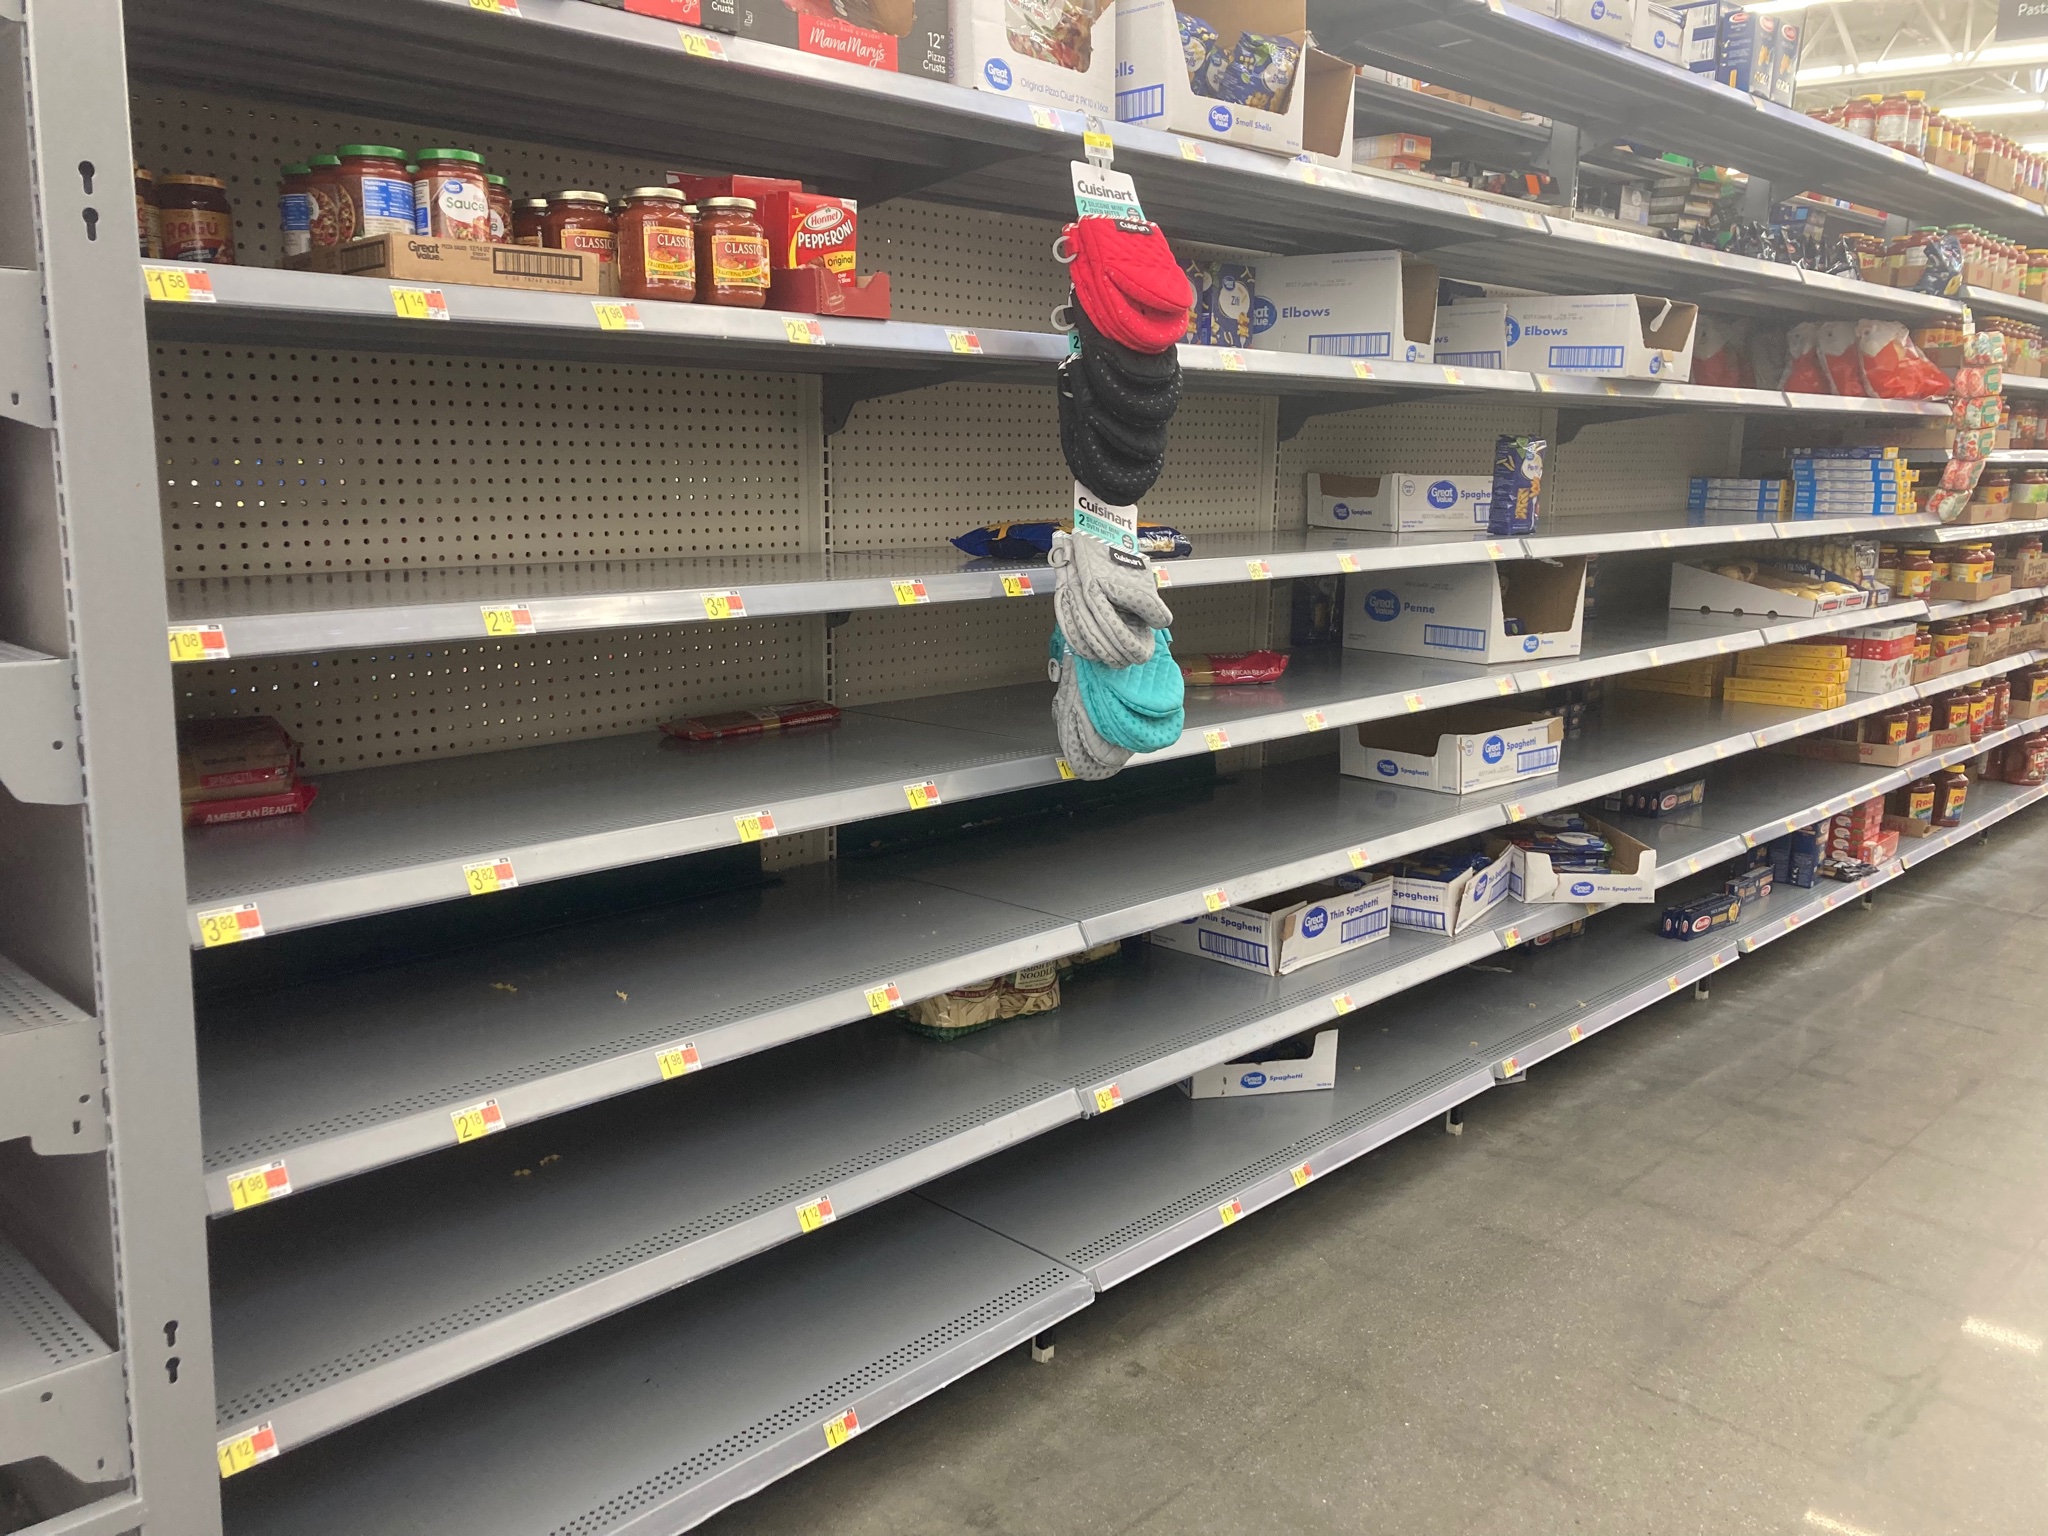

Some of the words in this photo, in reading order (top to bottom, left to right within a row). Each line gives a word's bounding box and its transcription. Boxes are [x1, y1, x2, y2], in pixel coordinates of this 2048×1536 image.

[711, 2, 735, 15] Crusts
[927, 50, 946, 64] Pizza
[923, 60, 946, 74] Crusts
[987, 63, 1008, 79] Great
[1020, 78, 1044, 93] Original
[1044, 86, 1060, 98] Pizza
[1060, 90, 1075, 103] Crust
[1211, 110, 1229, 121] Great
[1235, 117, 1253, 128] Small
[1254, 121, 1272, 132] Shells
[1077, 180, 1134, 202] Cuisinart
[446, 196, 485, 213] Sauce
[1081, 199, 1089, 213] 2
[810, 211, 839, 227] Hormel
[797, 219, 854, 249] PEPPERONI
[408, 240, 440, 254] Great
[827, 255, 854, 269] Original
[1282, 307, 1331, 319] Elbows
[1524, 325, 1568, 337] Elbows
[1431, 487, 1454, 499] Great
[1078, 496, 1133, 531] Cuisinart
[1078, 513, 1086, 527] 2
[1086, 516, 1108, 530] SILICONE
[1108, 523, 1120, 536] MINI
[1086, 522, 1099, 533] OVEN
[1099, 528, 1115, 540] MITTS
[1113, 552, 1142, 567] Cuisinart
[1368, 594, 1395, 610] Great
[1404, 602, 1436, 615] Penne
[1484, 740, 1502, 754] Great
[1506, 737, 1537, 753] Spaghetti
[1400, 767, 1430, 778] Spaghetti
[204, 806, 260, 825] AMERICAN
[1611, 885, 1643, 893] Spaghetti
[1393, 890, 1439, 903] Spaghetti
[1330, 908, 1345, 920] Thin
[1346, 896, 1379, 916] Spaghetti
[1220, 915, 1263, 934] Spaghetti
[1304, 912, 1324, 927] Great
[1243, 1074, 1262, 1082] Great
[1269, 1072, 1304, 1081] Spaghetti
